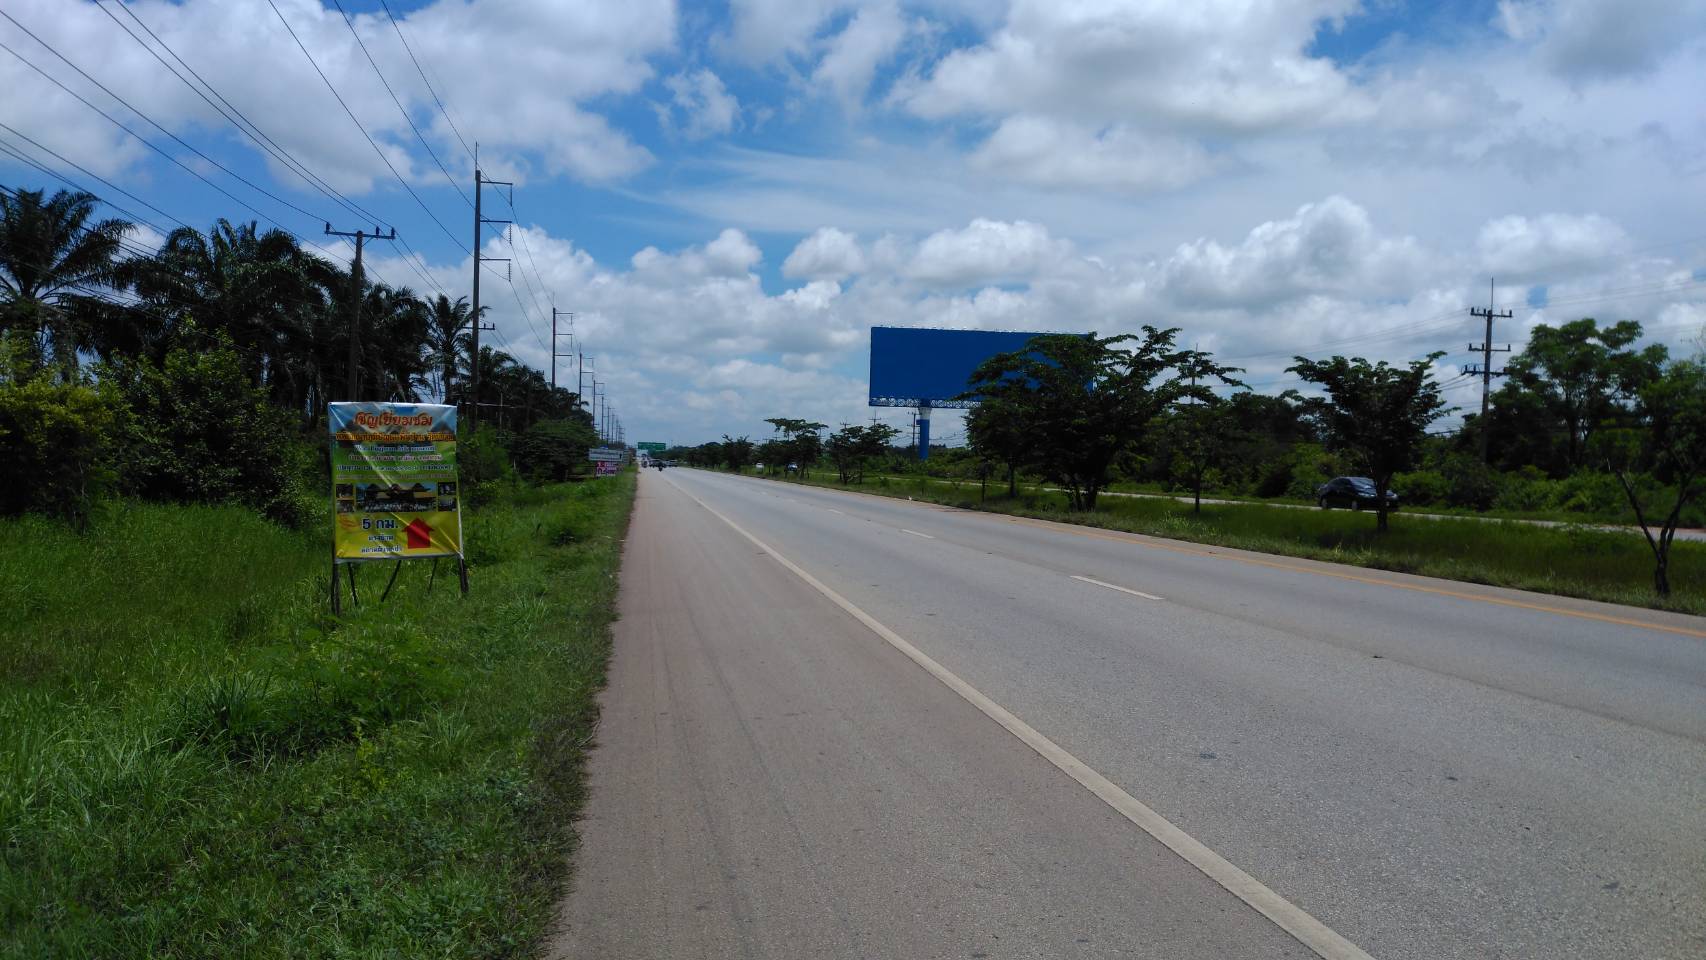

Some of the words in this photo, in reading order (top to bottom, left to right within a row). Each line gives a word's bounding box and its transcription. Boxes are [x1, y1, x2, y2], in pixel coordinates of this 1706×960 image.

[355, 410, 433, 428] เชิญเยี่ยมชม
[362, 518, 371, 530] 5
[376, 519, 399, 529] กม.
